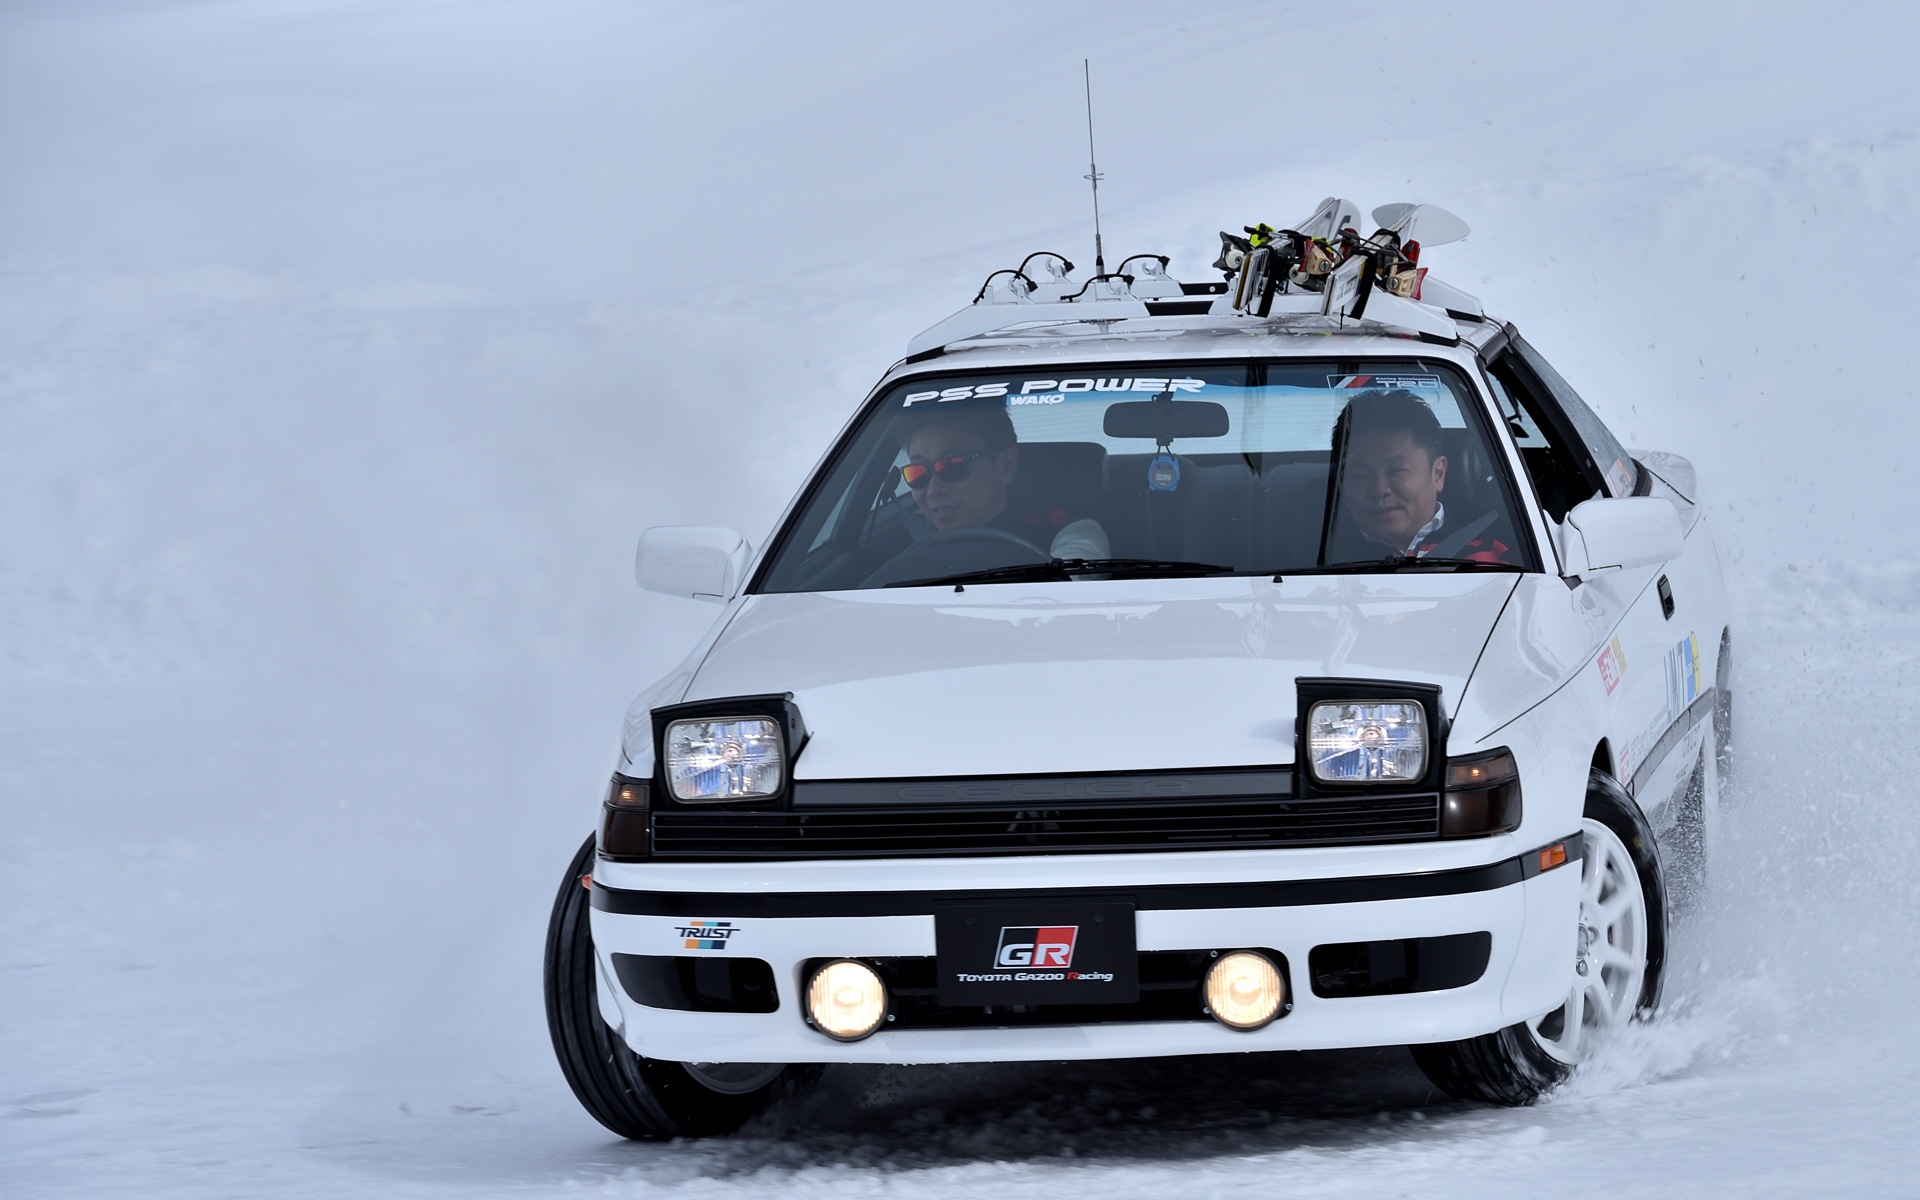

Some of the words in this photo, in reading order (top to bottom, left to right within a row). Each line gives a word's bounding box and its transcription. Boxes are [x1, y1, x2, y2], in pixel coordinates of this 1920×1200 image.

[1376, 380, 1438, 388] TRD
[903, 382, 1010, 407] PSS
[1020, 378, 1206, 394] POWER
[674, 926, 741, 939] TRUST
[999, 943, 1071, 966] GR
[956, 973, 1012, 982] TOYOTA
[1014, 972, 1065, 981] GAZOO
[1066, 971, 1114, 982] Racing
